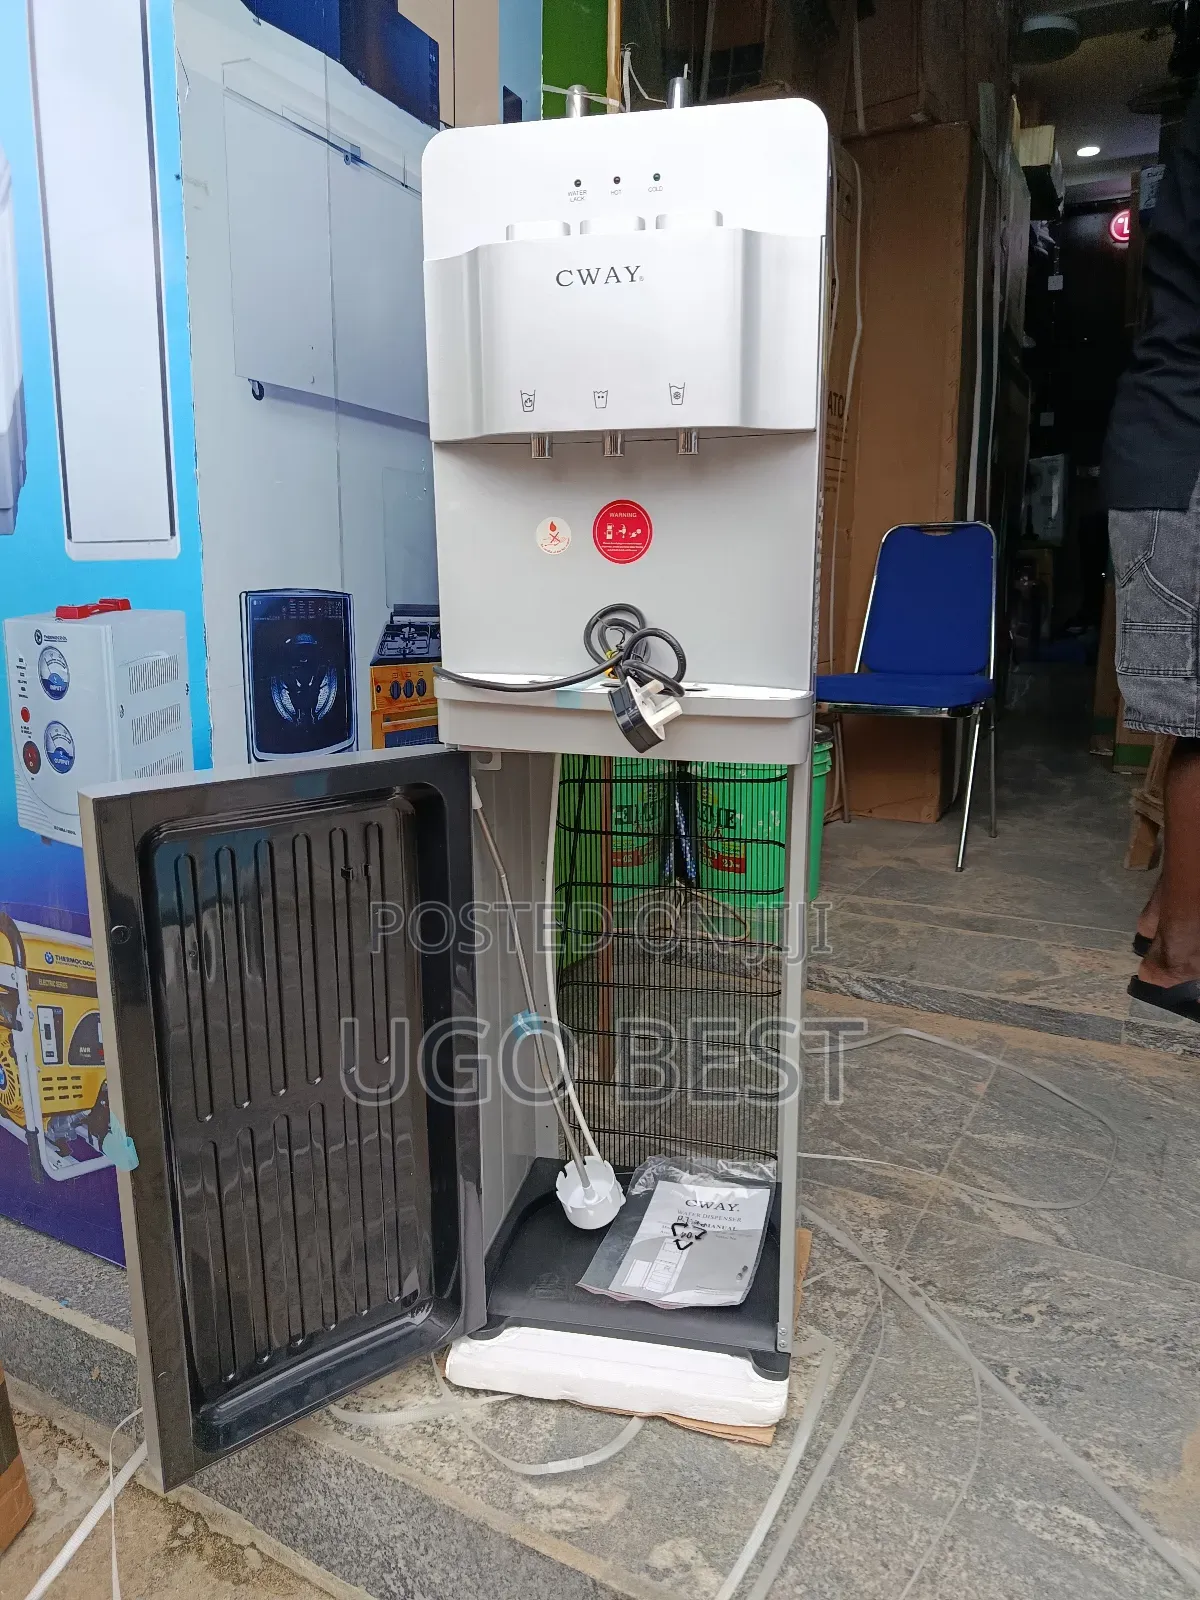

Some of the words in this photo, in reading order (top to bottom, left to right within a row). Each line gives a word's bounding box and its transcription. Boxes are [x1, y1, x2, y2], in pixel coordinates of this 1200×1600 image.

[54, 954, 94, 967] THERMOCOOL
[677, 1209, 703, 1218] WATER
[702, 1213, 742, 1223] DISPENSER
